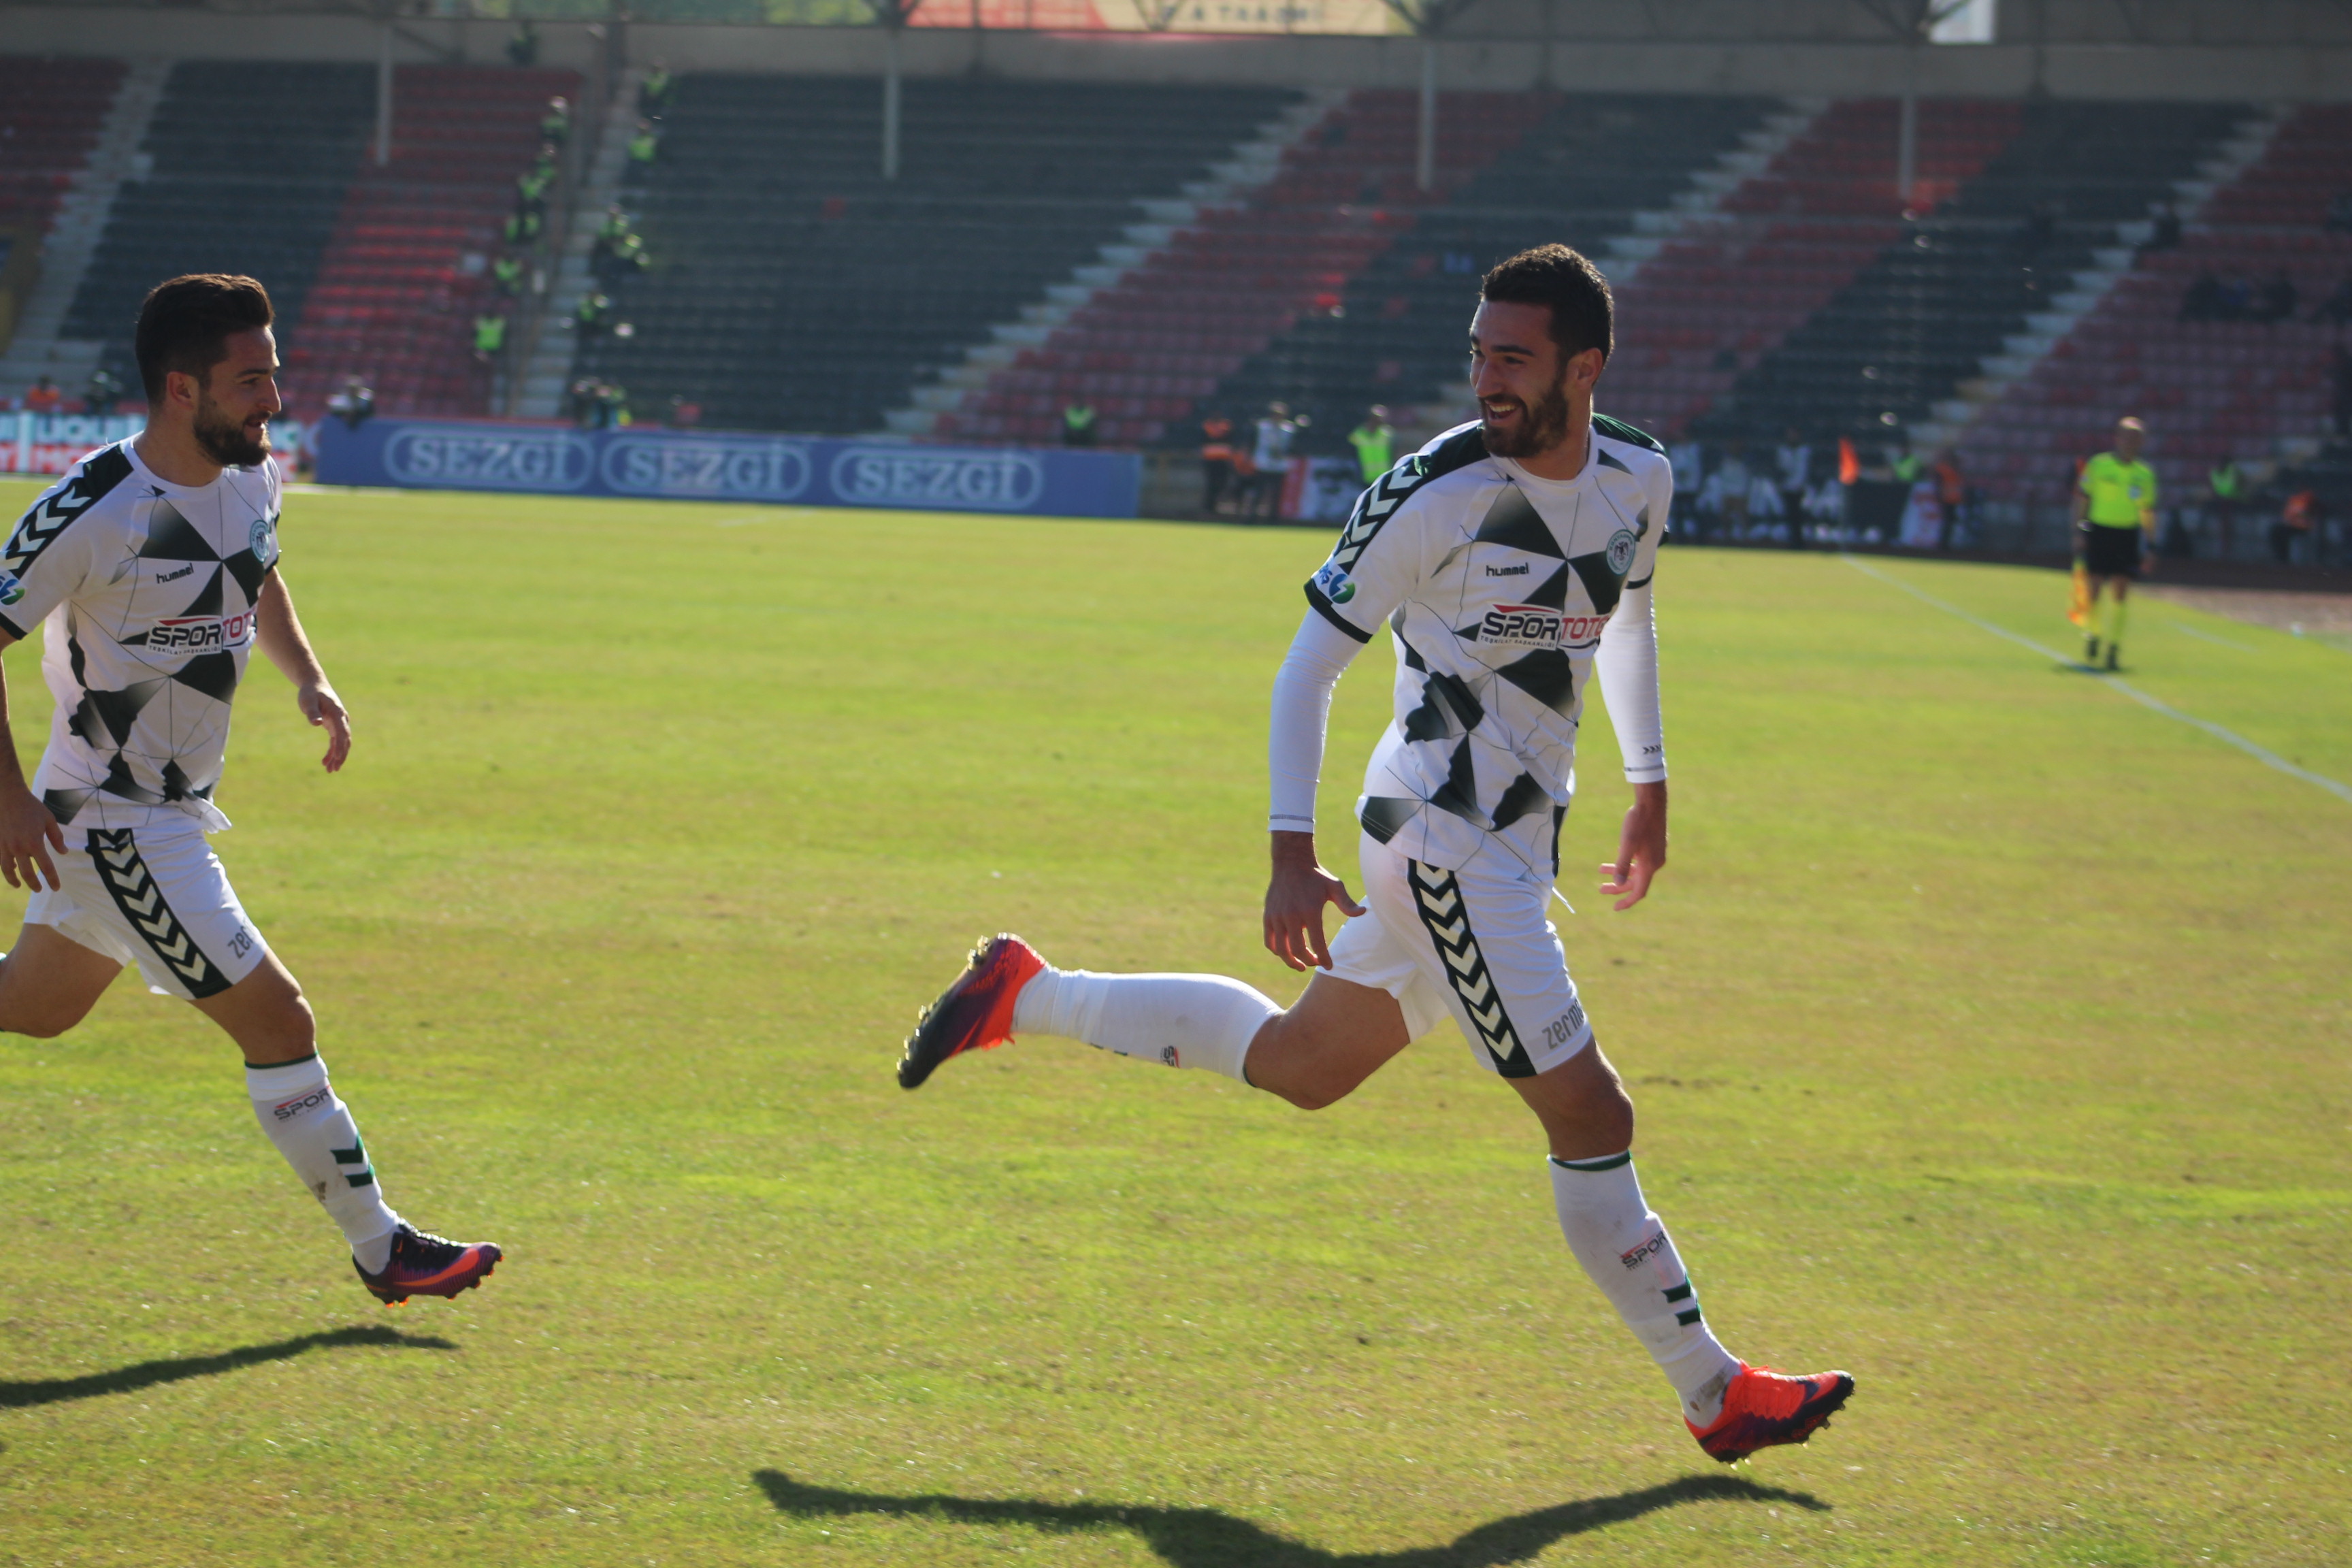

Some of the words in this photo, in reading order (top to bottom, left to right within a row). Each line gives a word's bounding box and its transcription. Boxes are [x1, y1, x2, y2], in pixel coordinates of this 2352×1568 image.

[156, 562, 194, 584] hummel
[1486, 562, 1529, 576] hummel
[274, 1088, 329, 1120] SPOR
[1622, 1230, 1668, 1268] SPOR
